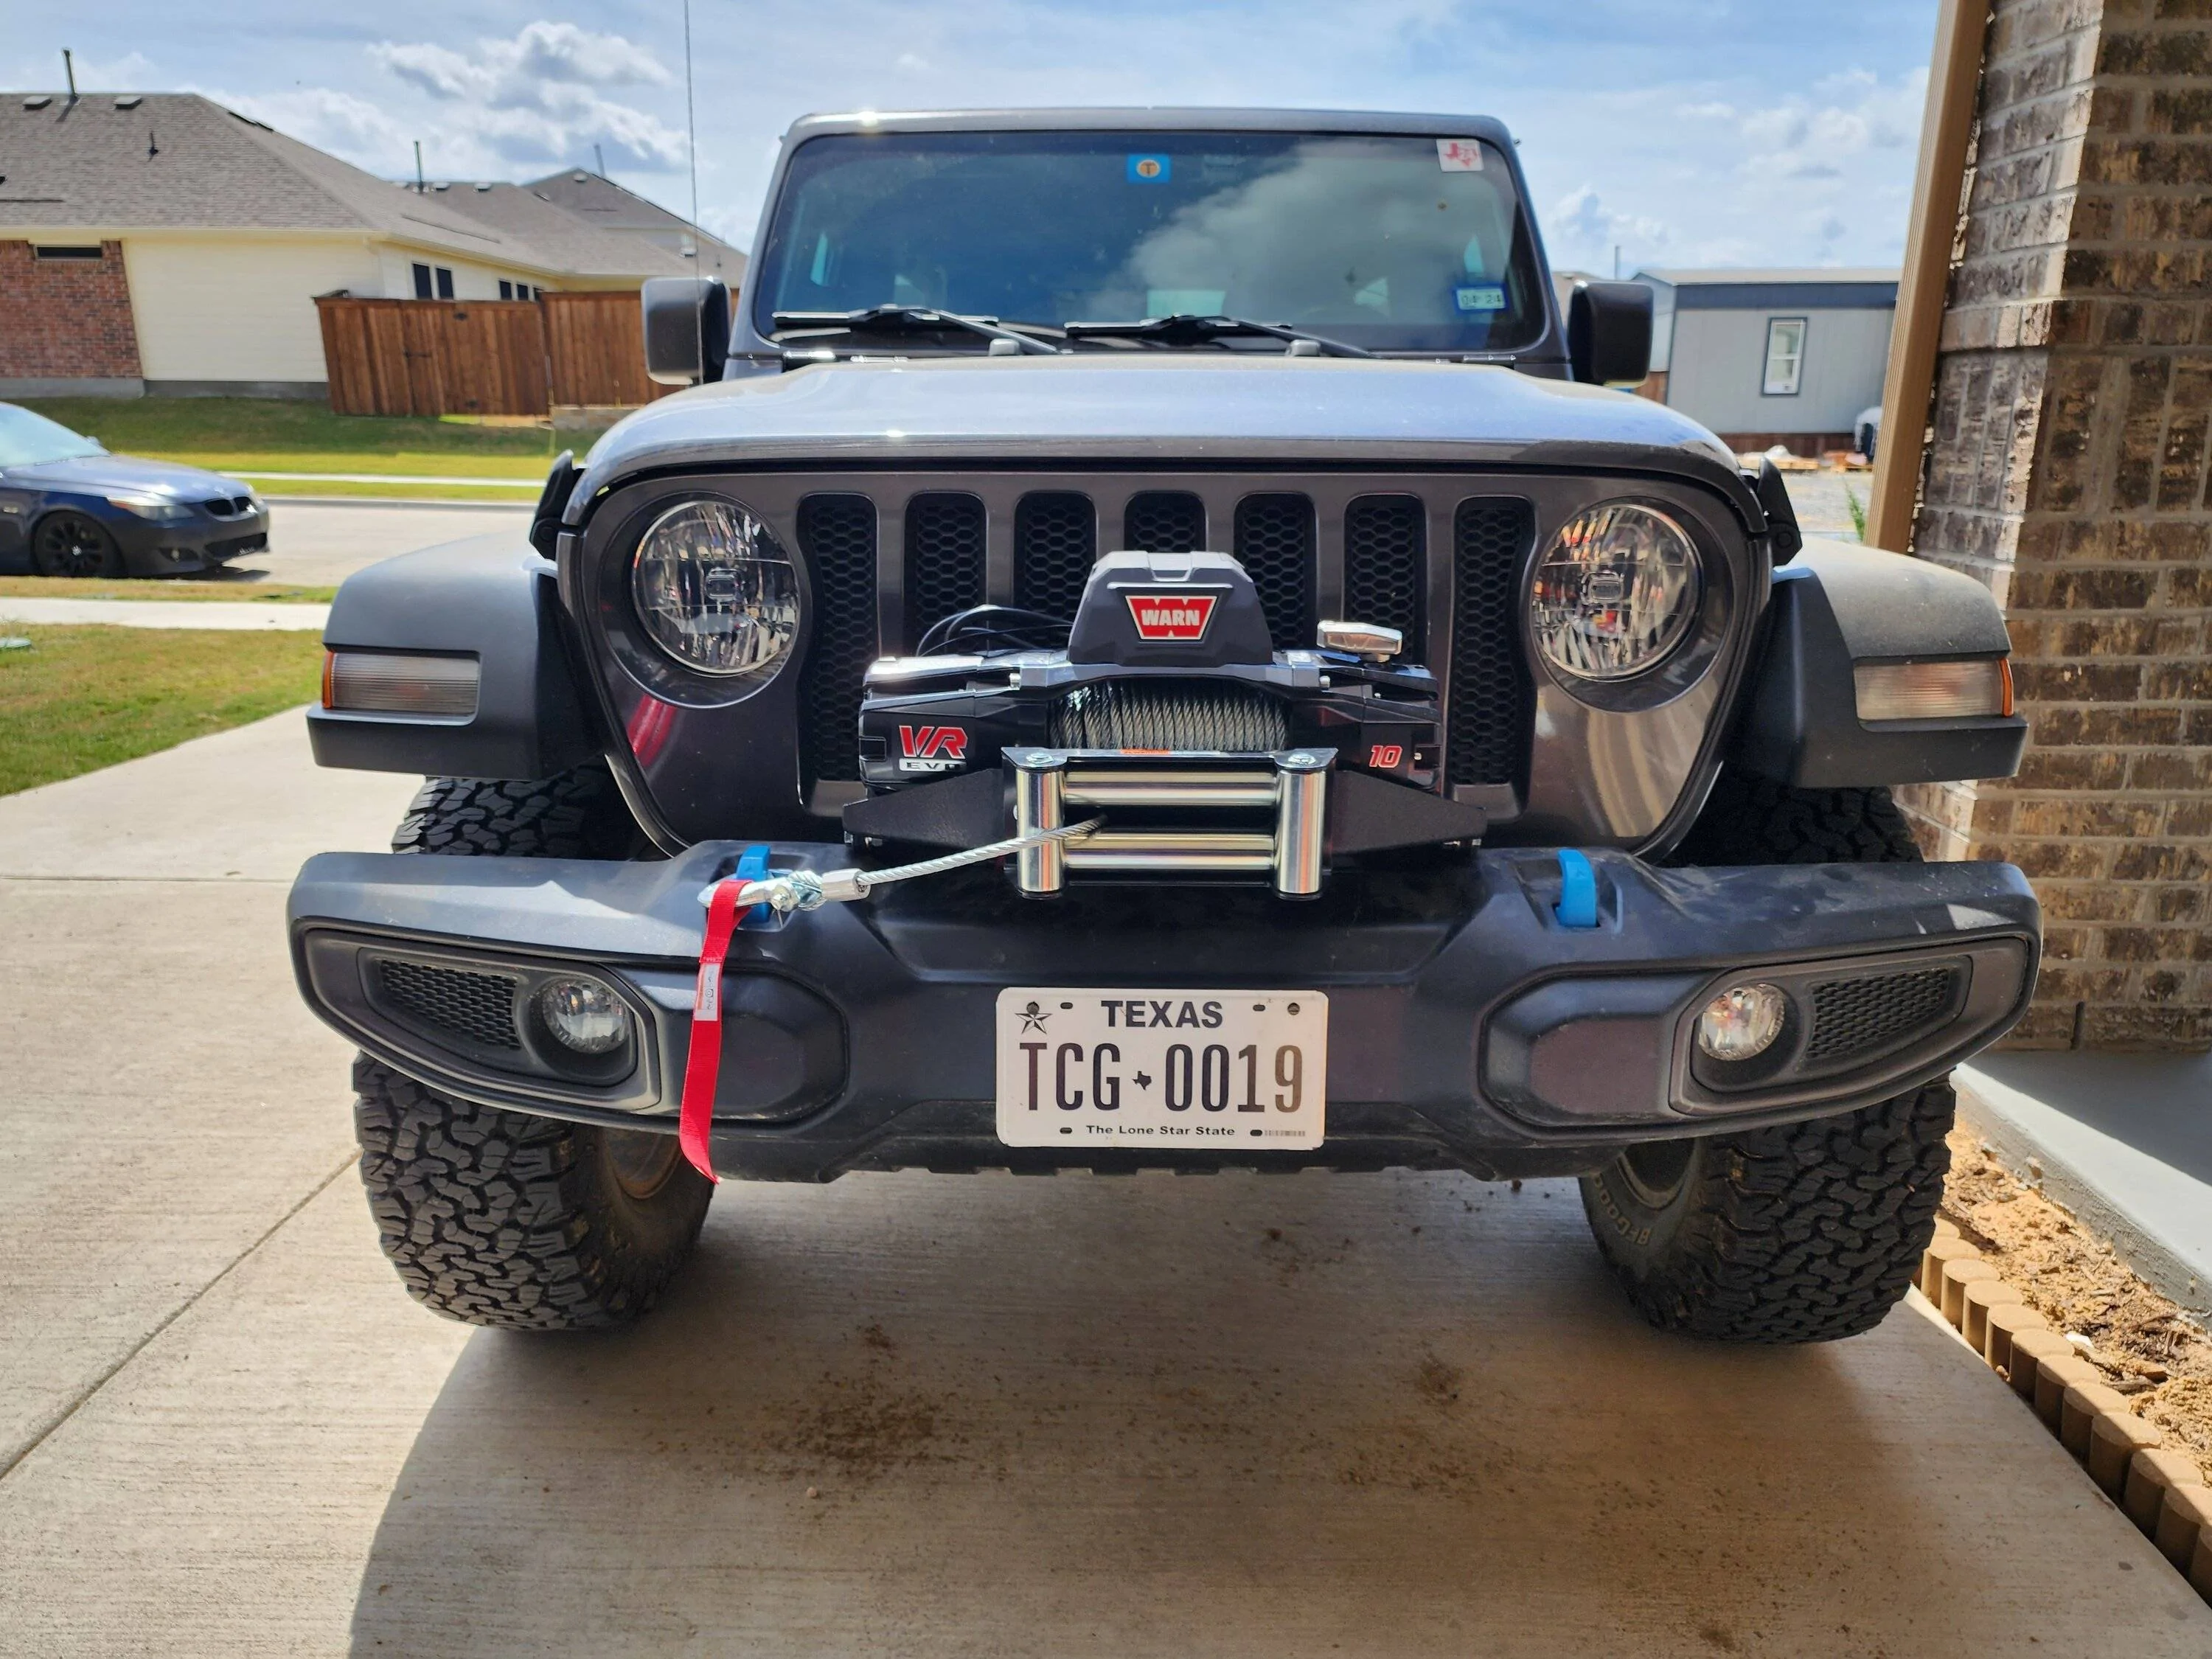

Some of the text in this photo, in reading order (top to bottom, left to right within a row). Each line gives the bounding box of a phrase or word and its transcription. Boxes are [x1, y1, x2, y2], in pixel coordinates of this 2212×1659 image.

[1141, 610, 1200, 626] WARN
[899, 725, 968, 759] VR
[1369, 745, 1403, 768] 10
[1101, 1000, 1223, 1028] TEXAS
[1019, 1042, 1303, 1113] TCG 0019
[1086, 1124, 1235, 1136] The Lone Star State
